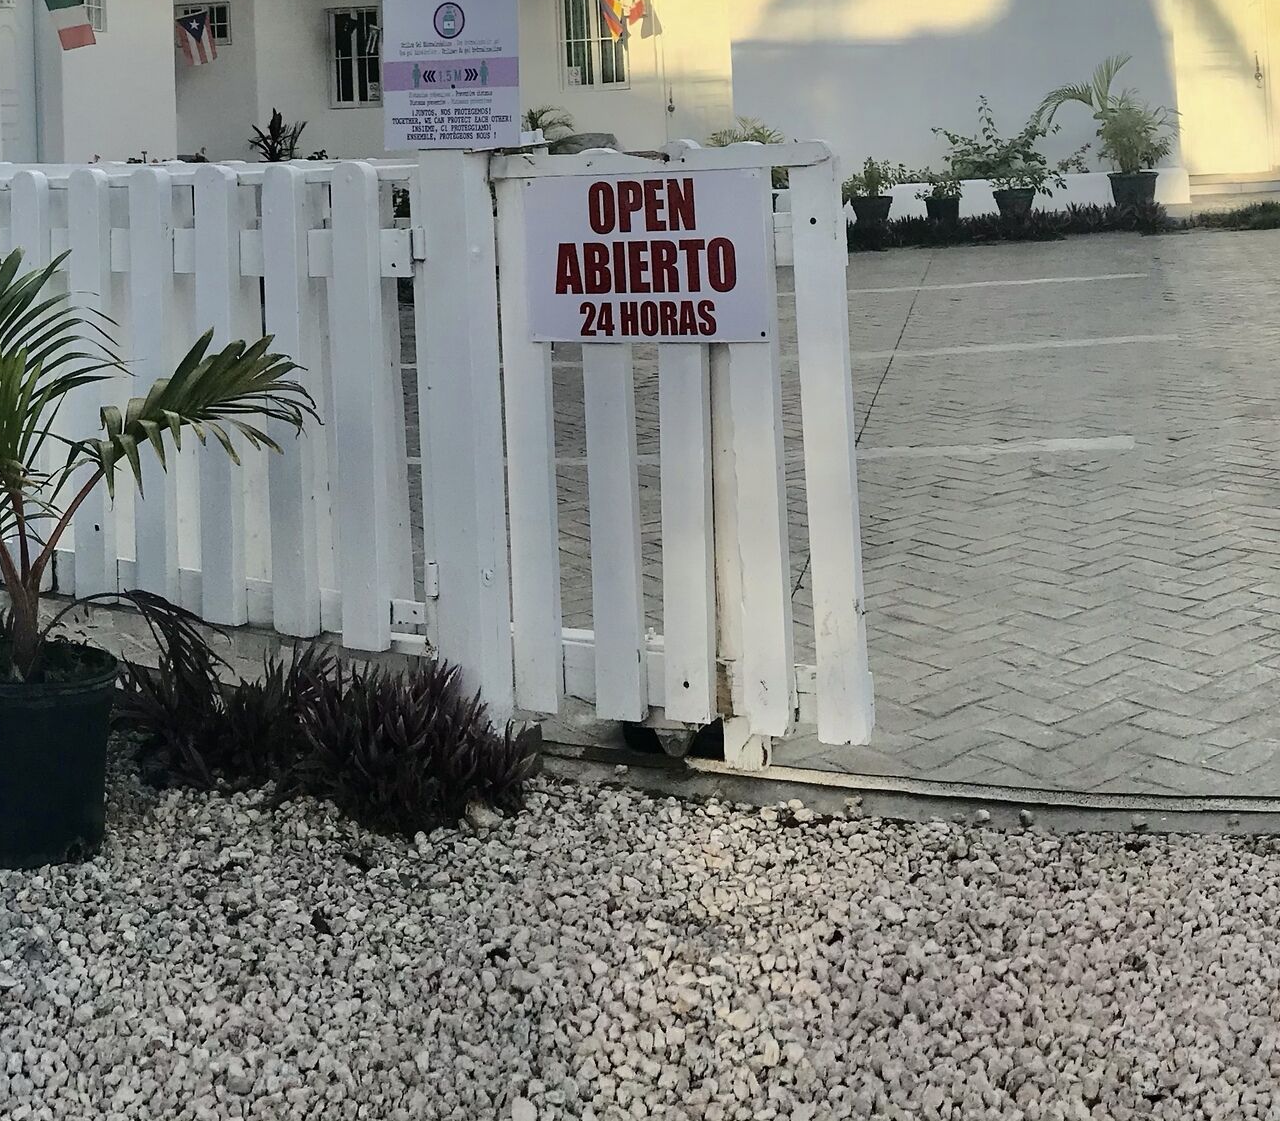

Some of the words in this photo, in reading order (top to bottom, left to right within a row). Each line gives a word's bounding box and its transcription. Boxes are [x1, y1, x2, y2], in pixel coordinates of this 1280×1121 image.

[434, 116, 445, 124] CAN
[447, 116, 472, 124] PROTECT
[474, 115, 489, 123] EACH
[440, 108, 451, 116] NOS
[588, 177, 696, 235] OPEN
[555, 237, 737, 295] ABIERTO
[579, 301, 615, 337] 24
[620, 299, 717, 337] HORAS
